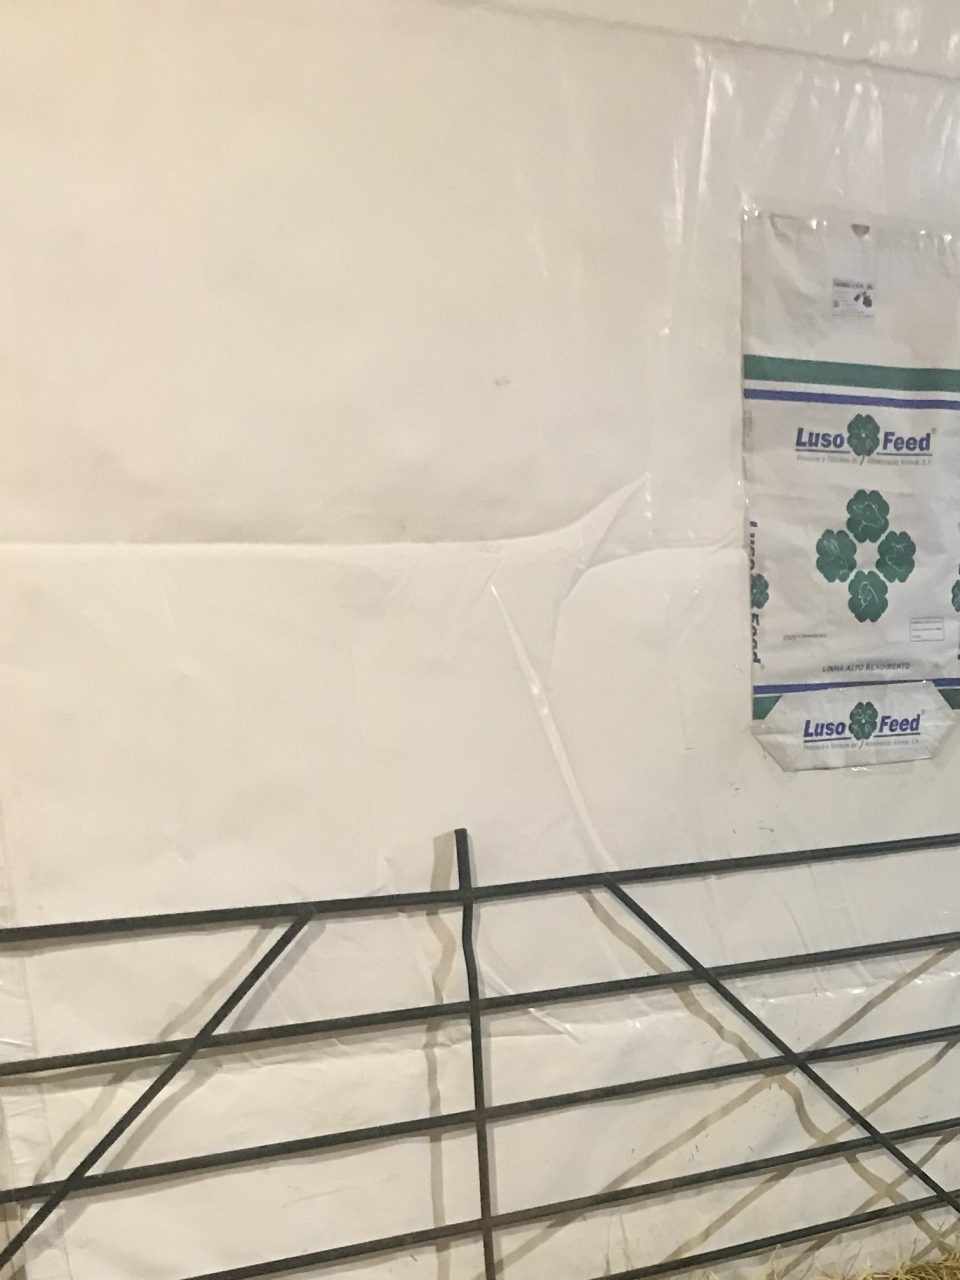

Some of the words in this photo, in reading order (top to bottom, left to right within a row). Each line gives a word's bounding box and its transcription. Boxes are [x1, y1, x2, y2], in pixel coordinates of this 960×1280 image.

[795, 427, 845, 449] Luso
[882, 431, 931, 452] Feed
[845, 663, 864, 672] ALTO
[803, 719, 847, 738] Luso
[879, 713, 921, 733] Feed
